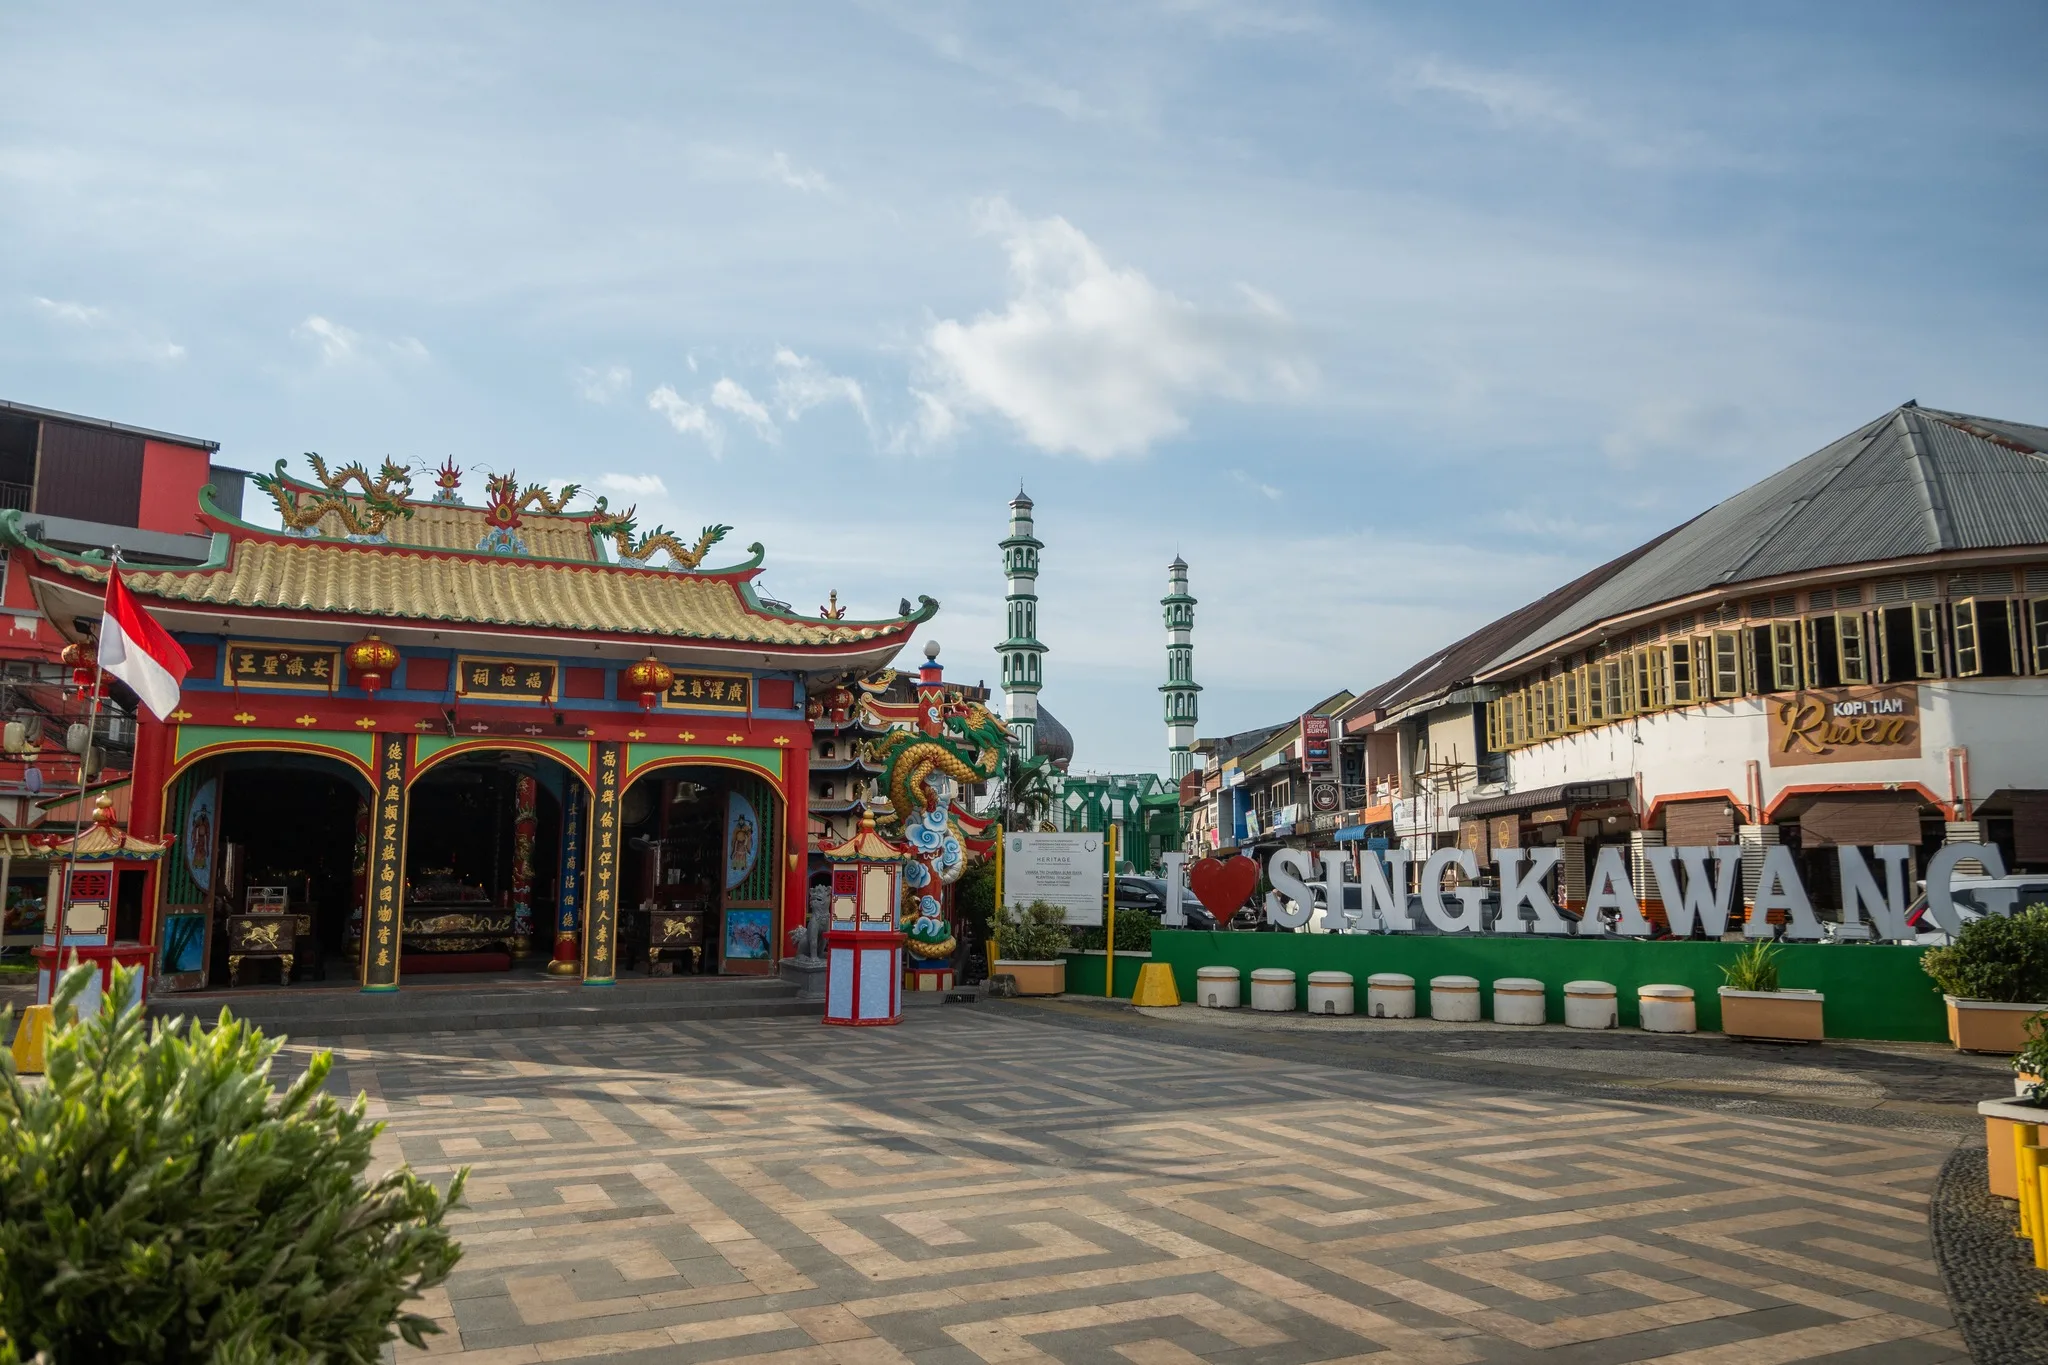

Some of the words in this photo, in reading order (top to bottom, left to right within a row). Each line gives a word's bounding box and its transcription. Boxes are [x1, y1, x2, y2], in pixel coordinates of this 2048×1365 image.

[1775, 699, 1905, 753] Rusen
[1833, 701, 1868, 716] KOPI
[1871, 699, 1903, 715] TIAM
[1161, 852, 1188, 926] I
[1267, 842, 2019, 940] SINGKAWANG
